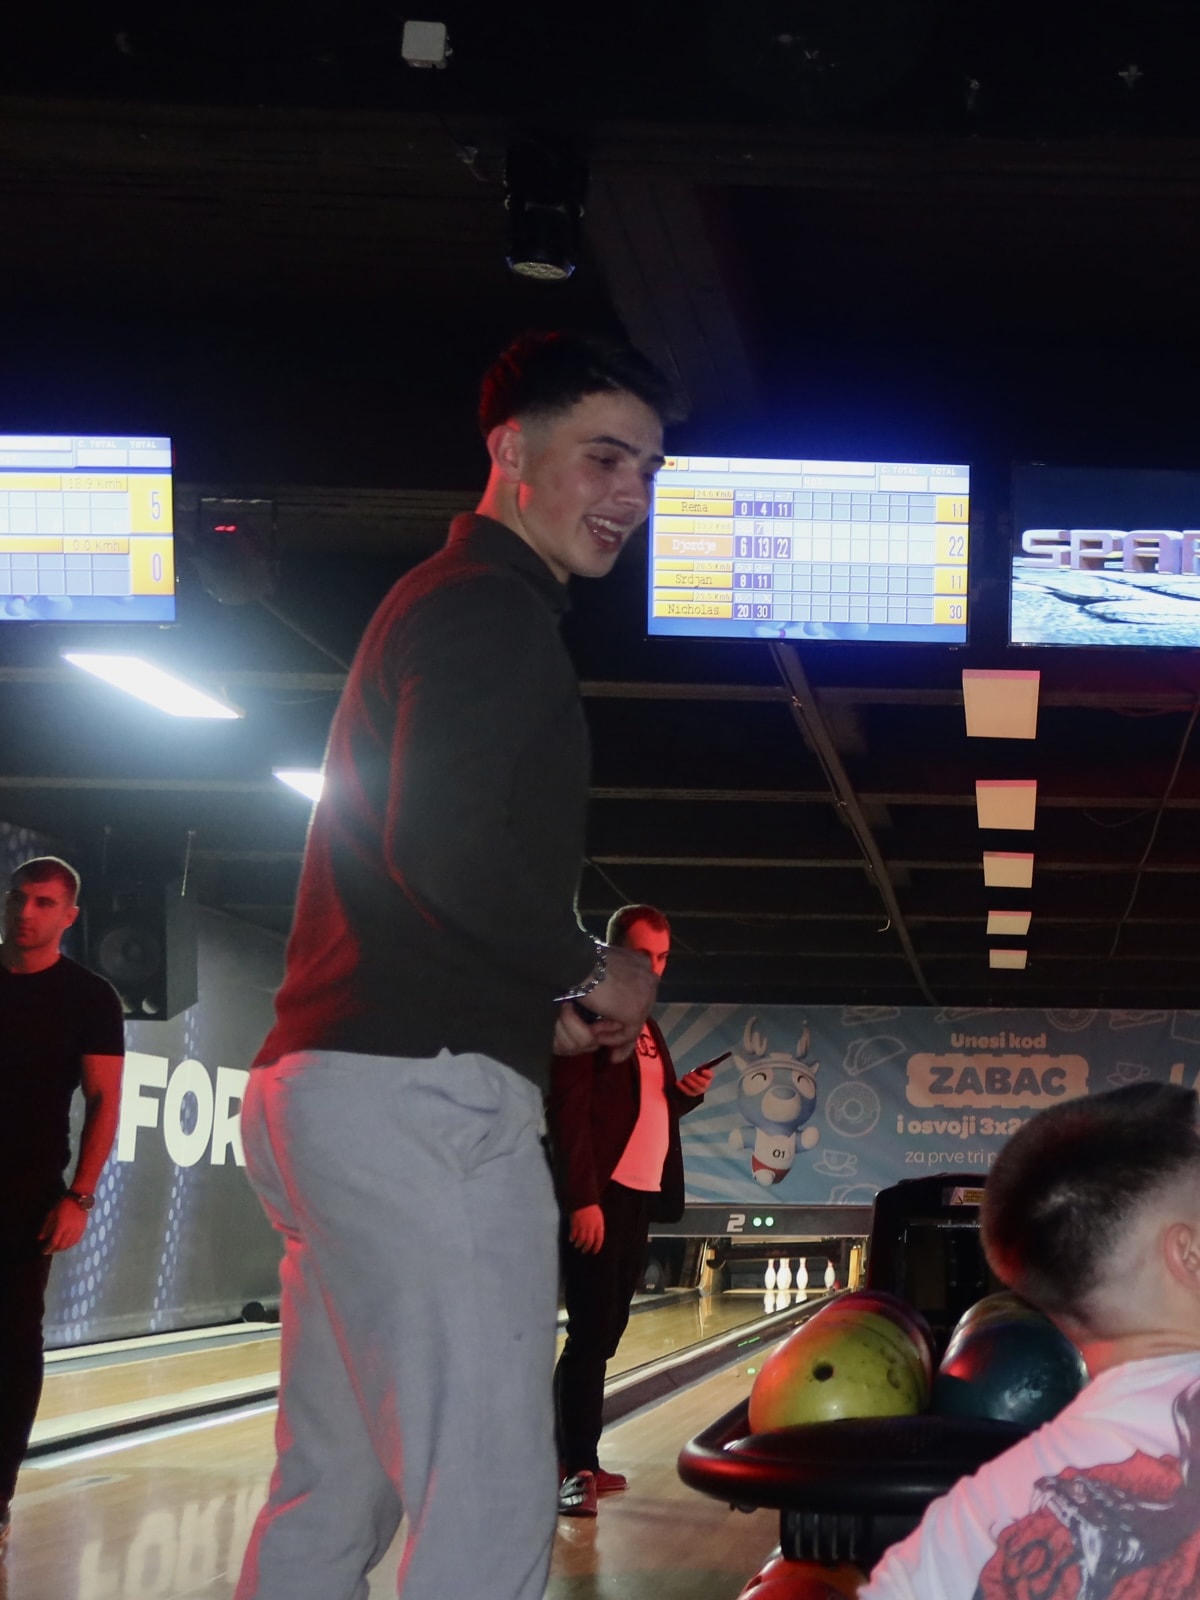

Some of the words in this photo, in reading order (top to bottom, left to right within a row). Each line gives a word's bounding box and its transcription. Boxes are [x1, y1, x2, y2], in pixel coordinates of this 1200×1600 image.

[90, 440, 116, 448] TOTAL
[129, 440, 156, 449] TOTAL
[893, 467, 918, 475] TOTAL
[151, 491, 161, 520] 5
[681, 501, 708, 513] Rema
[741, 503, 748, 514] 0
[760, 504, 767, 516] 4
[778, 504, 788, 516] 11
[952, 503, 963, 518] 11
[740, 537, 747, 557] 6
[758, 537, 769, 557] 13
[777, 538, 788, 558] 22
[948, 536, 964, 557] 22
[152, 553, 162, 582] 0
[675, 574, 712, 588] Srdjan
[758, 576, 768, 587] 11
[951, 575, 962, 589] 11
[668, 604, 719, 615] Nicholas
[737, 604, 749, 617] 20
[757, 605, 768, 618] 30
[949, 605, 962, 619] 30
[951, 1033, 1005, 1048] Unesi
[1009, 1033, 1047, 1049] kod
[928, 1067, 1067, 1096] ZABAC
[117, 1050, 250, 1167] FOR
[896, 1115, 904, 1134] i
[908, 1115, 976, 1139] osvoji
[980, 1117, 1028, 1135] 3x2
[905, 1151, 925, 1163] za
[928, 1151, 964, 1167] prve
[967, 1149, 983, 1163] tri
[726, 1213, 746, 1233] 2
